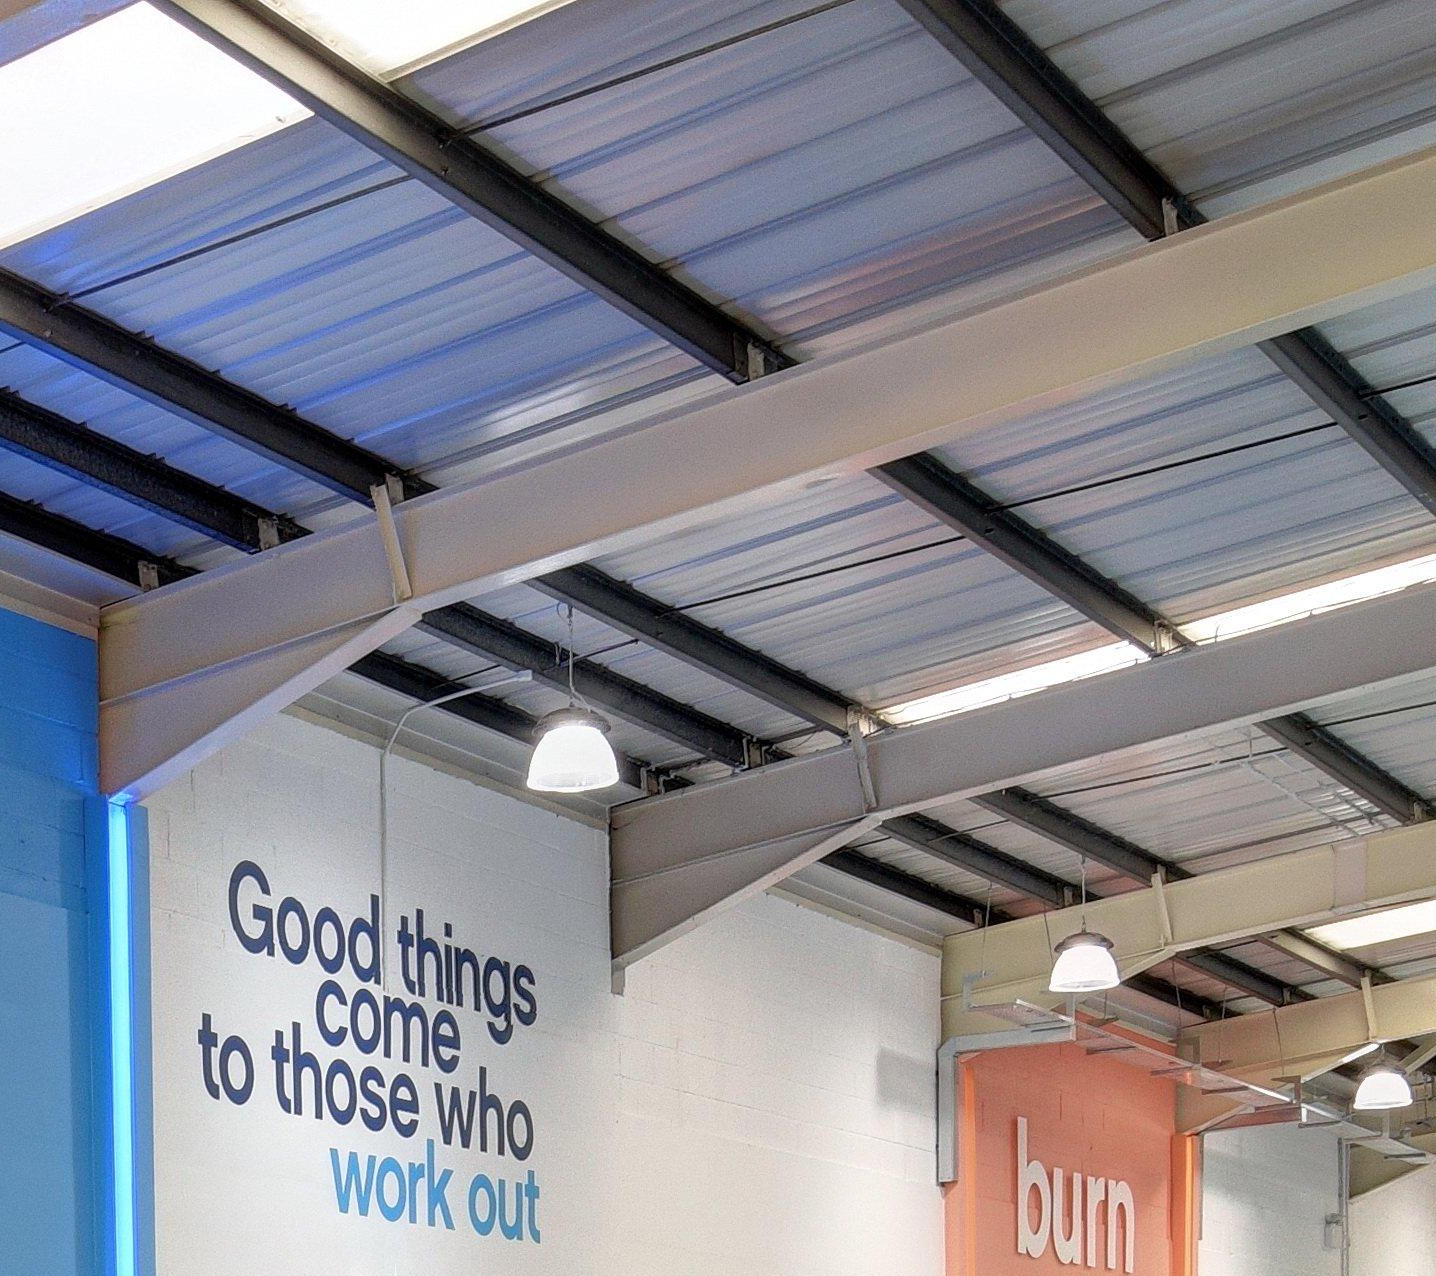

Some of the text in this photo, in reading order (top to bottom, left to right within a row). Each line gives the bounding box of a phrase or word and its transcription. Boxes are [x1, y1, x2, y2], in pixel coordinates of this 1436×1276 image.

[228, 860, 538, 1045] Good things
[316, 979, 461, 1074] come
[198, 1012, 535, 1162] to those who
[329, 1138, 541, 1244] work out
[1016, 1117, 1136, 1275] burn
